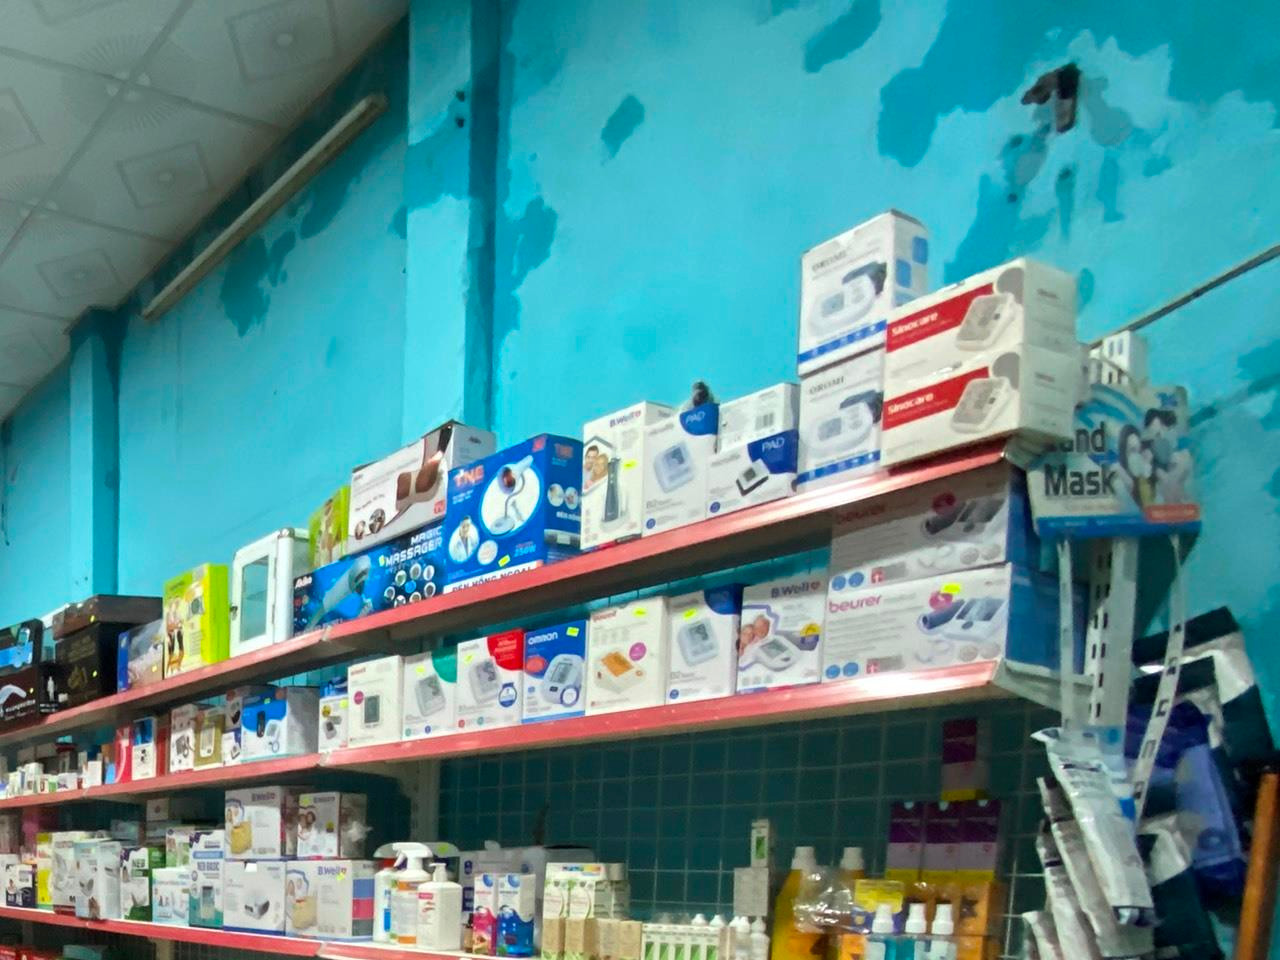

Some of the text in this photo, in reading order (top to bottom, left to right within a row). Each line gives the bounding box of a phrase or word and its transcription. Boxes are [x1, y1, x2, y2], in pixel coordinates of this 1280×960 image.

[685, 411, 705, 424] PAD
[762, 437, 785, 452] PAD
[1044, 464, 1117, 497] Mask
[410, 525, 442, 546] MAGIC
[385, 536, 443, 567] MASSAGER
[828, 594, 882, 614] beurer
